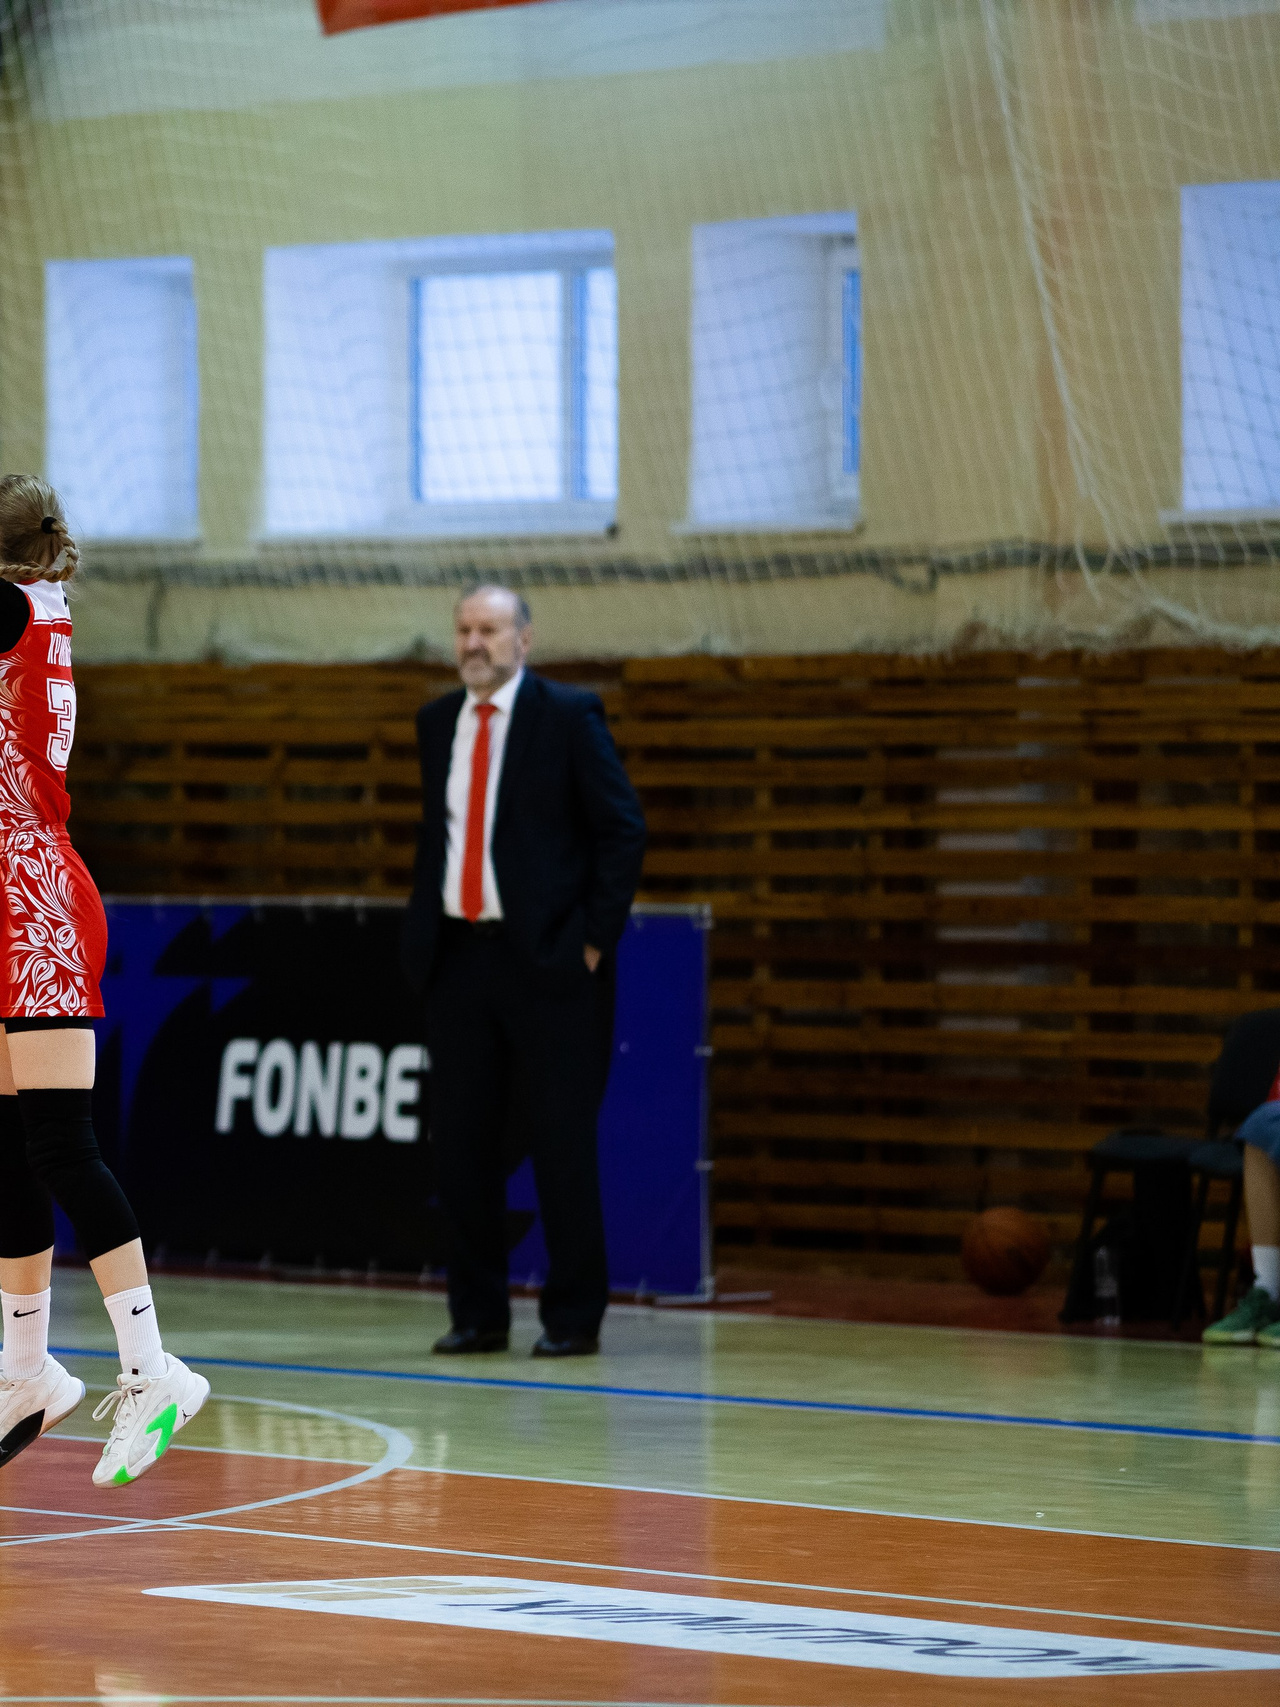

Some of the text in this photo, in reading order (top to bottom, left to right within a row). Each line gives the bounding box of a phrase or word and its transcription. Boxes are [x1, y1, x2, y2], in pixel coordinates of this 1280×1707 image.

[46, 678, 77, 772] 3
[214, 1036, 431, 1144] FONBE
[439, 1599, 1225, 1673] ХИМПРОМ
